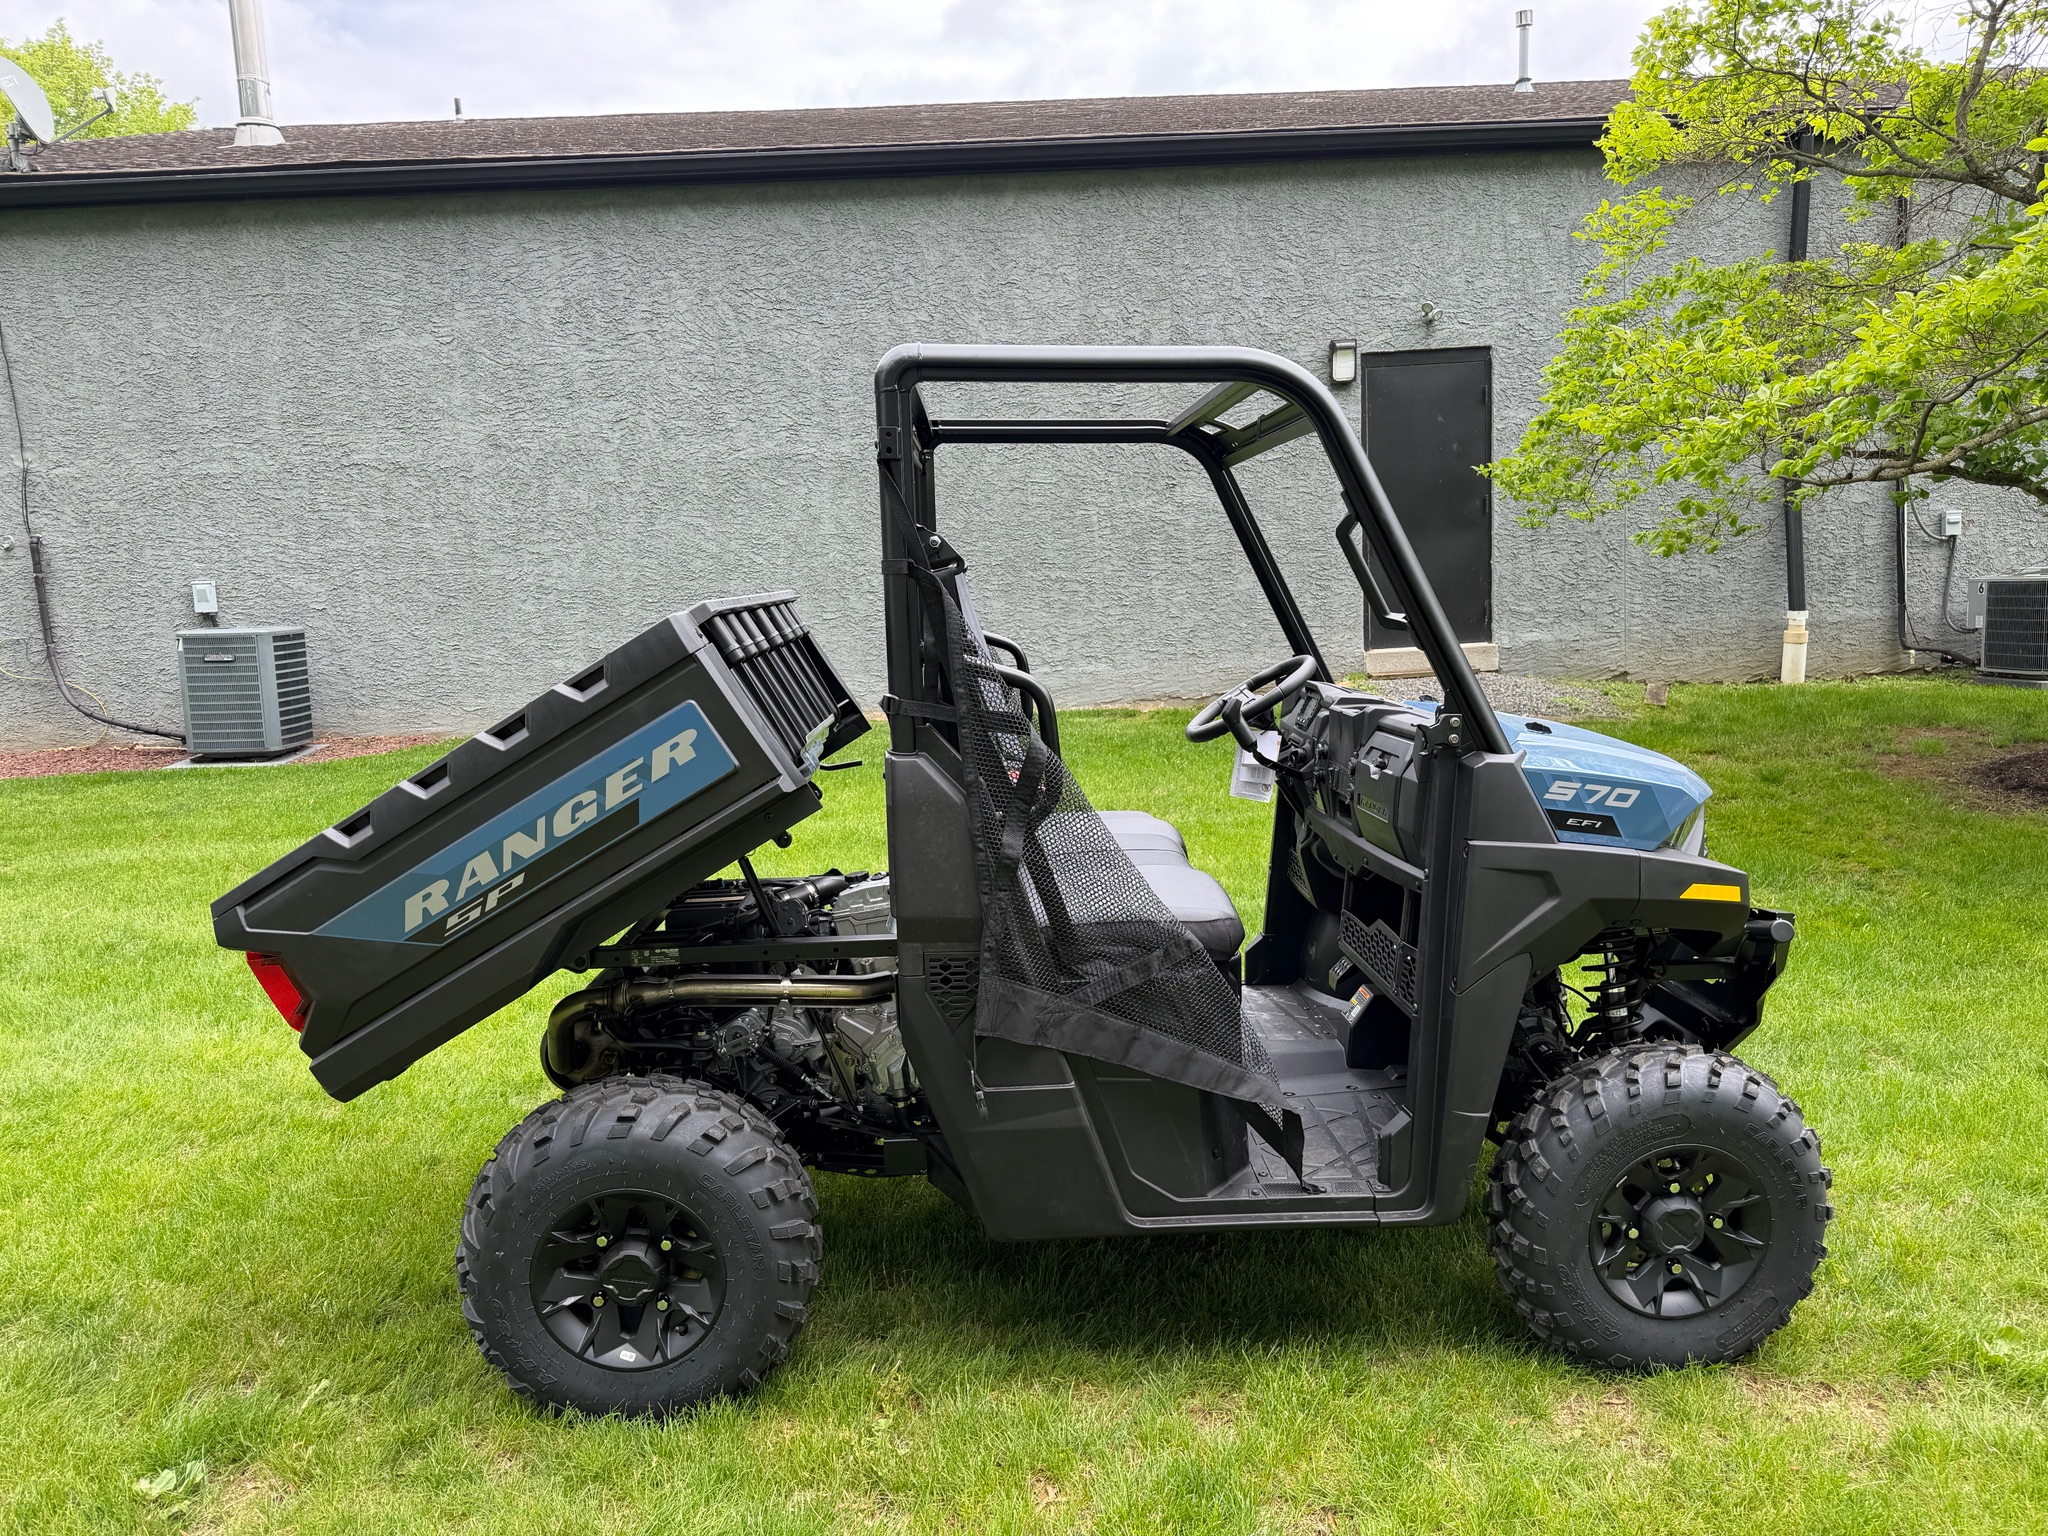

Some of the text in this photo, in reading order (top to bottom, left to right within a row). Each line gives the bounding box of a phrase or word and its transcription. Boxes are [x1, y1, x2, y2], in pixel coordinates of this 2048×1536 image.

[1978, 582, 1984, 594] 6
[1543, 780, 1641, 808] 570
[1566, 818, 1602, 828] EFI
[404, 728, 698, 933] RANGER
[444, 872, 526, 937] SP
[1743, 1122, 1807, 1209] CARLSTAR
[699, 1173, 765, 1270] CARLSTAR
